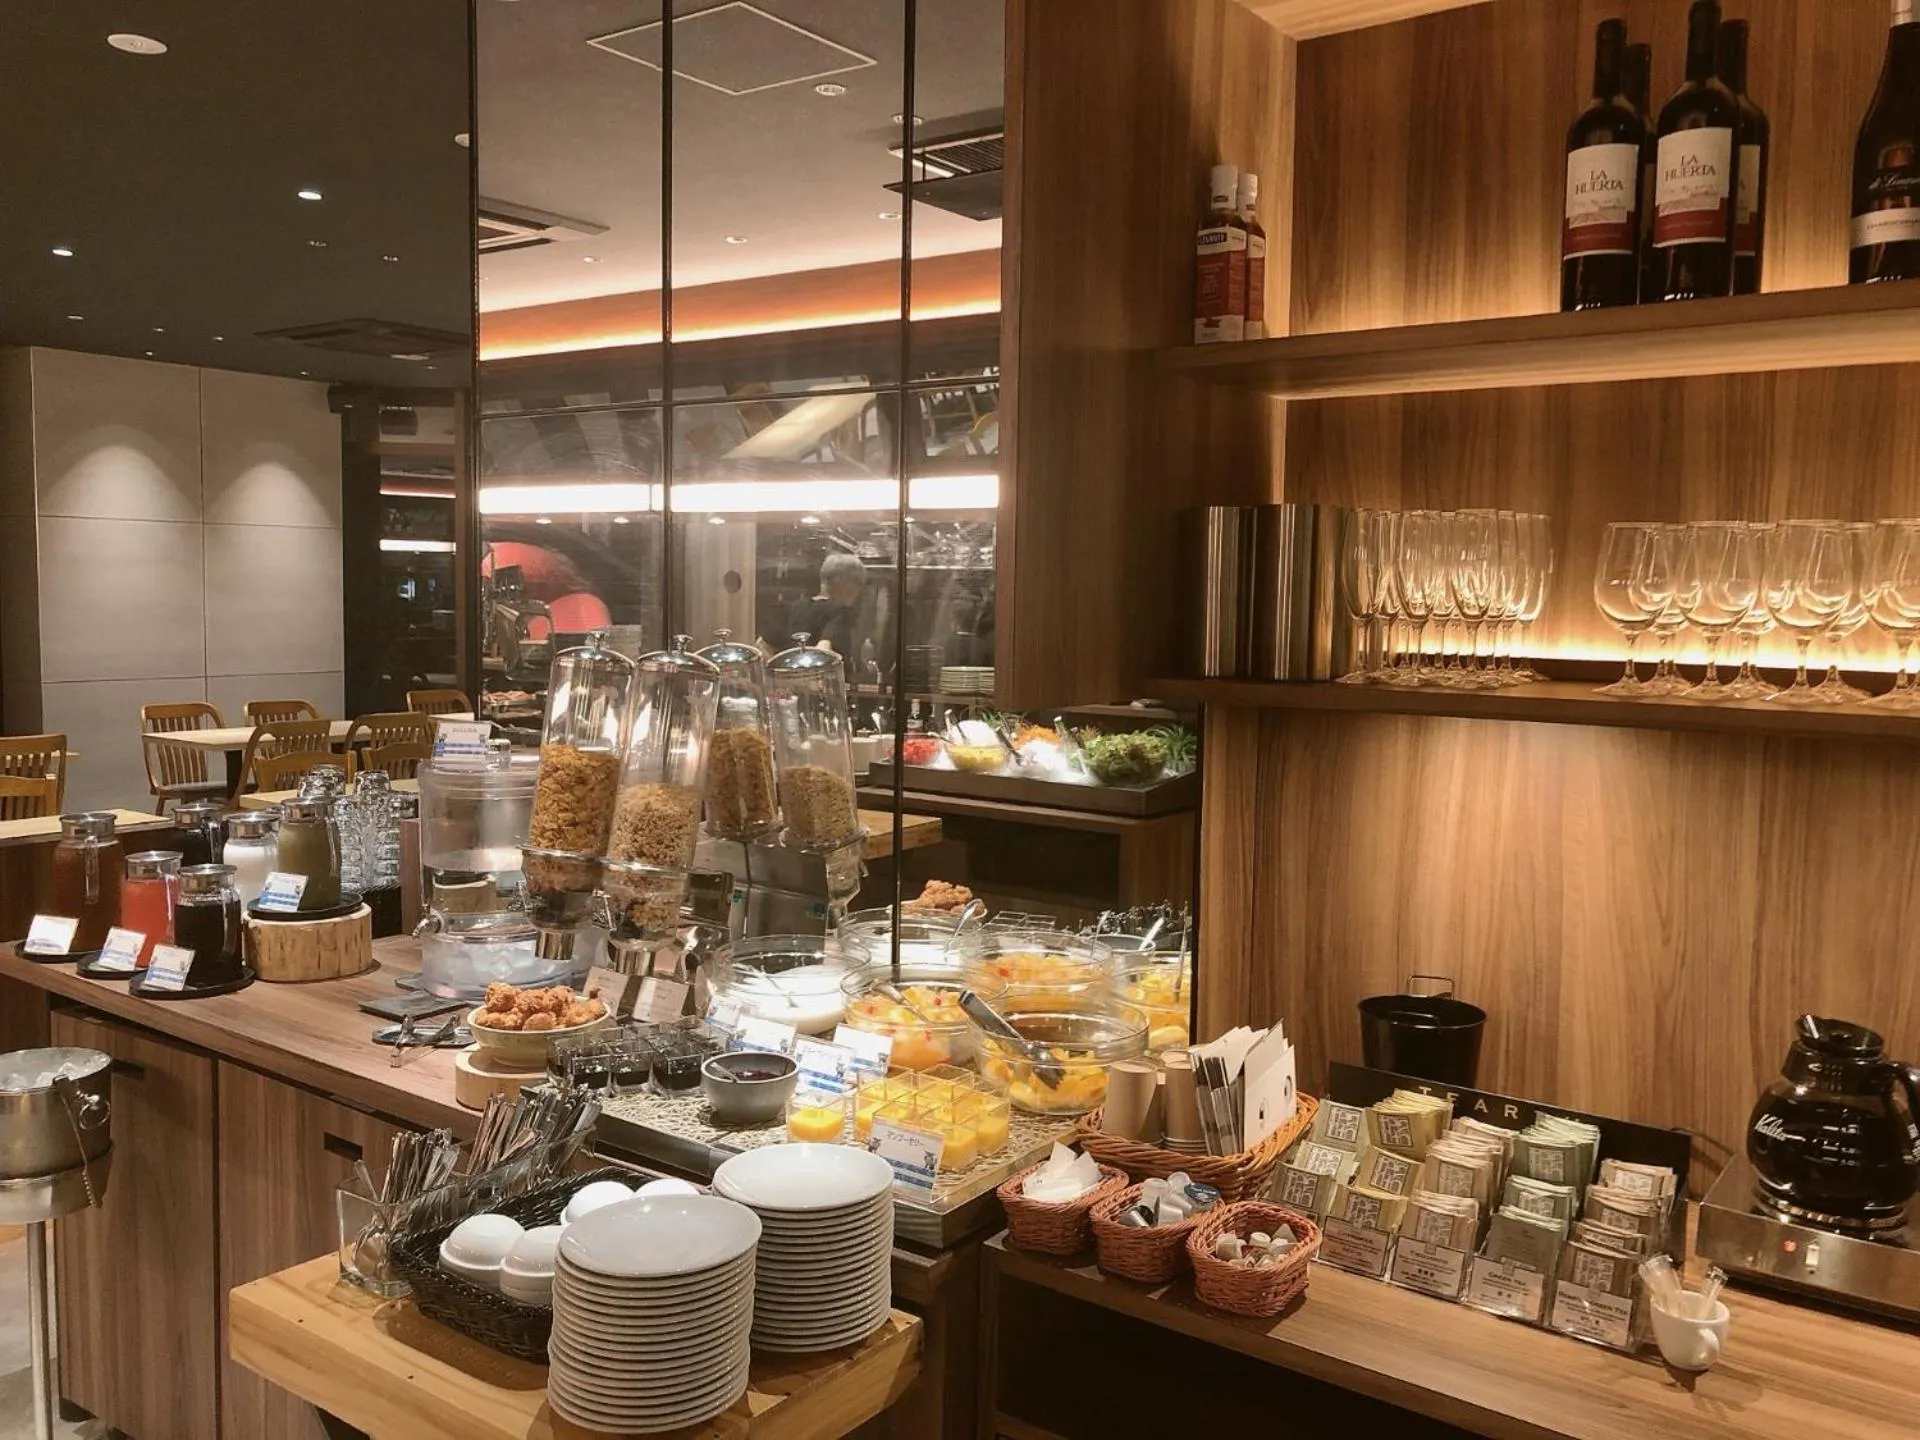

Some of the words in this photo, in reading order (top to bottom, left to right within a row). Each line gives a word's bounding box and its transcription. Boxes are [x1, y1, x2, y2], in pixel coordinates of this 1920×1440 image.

[1681, 154, 1698, 167] LA
[1590, 169, 1608, 181] LA
[1664, 164, 1716, 182] HUERTA
[1574, 179, 1624, 196] HUERTA
